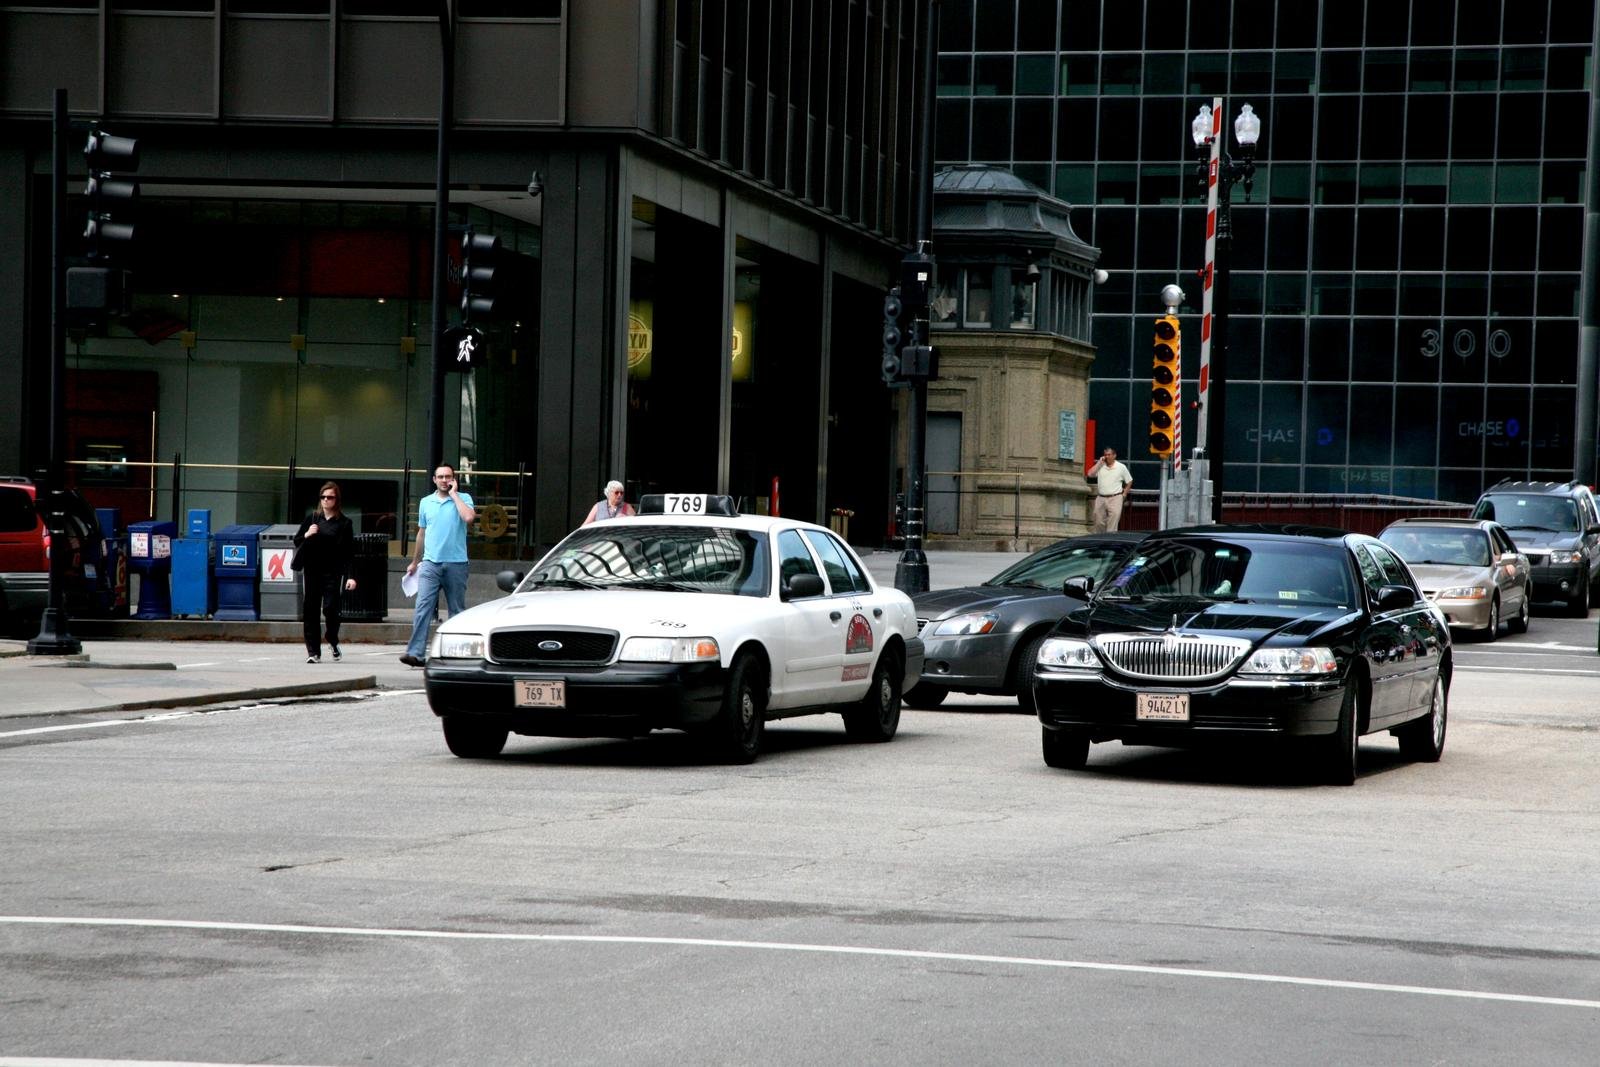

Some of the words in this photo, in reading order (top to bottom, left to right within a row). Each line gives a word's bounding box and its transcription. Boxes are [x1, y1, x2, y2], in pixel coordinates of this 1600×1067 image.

[1420, 328, 1511, 358] 300
[1246, 428, 1295, 443] CHAS
[1458, 420, 1504, 437] CHASE
[669, 496, 702, 513] 769
[649, 619, 687, 629] 769
[525, 687, 542, 700] 769
[550, 687, 562, 701] TX
[1148, 700, 1172, 713] 9442
[1175, 701, 1187, 714] LY
